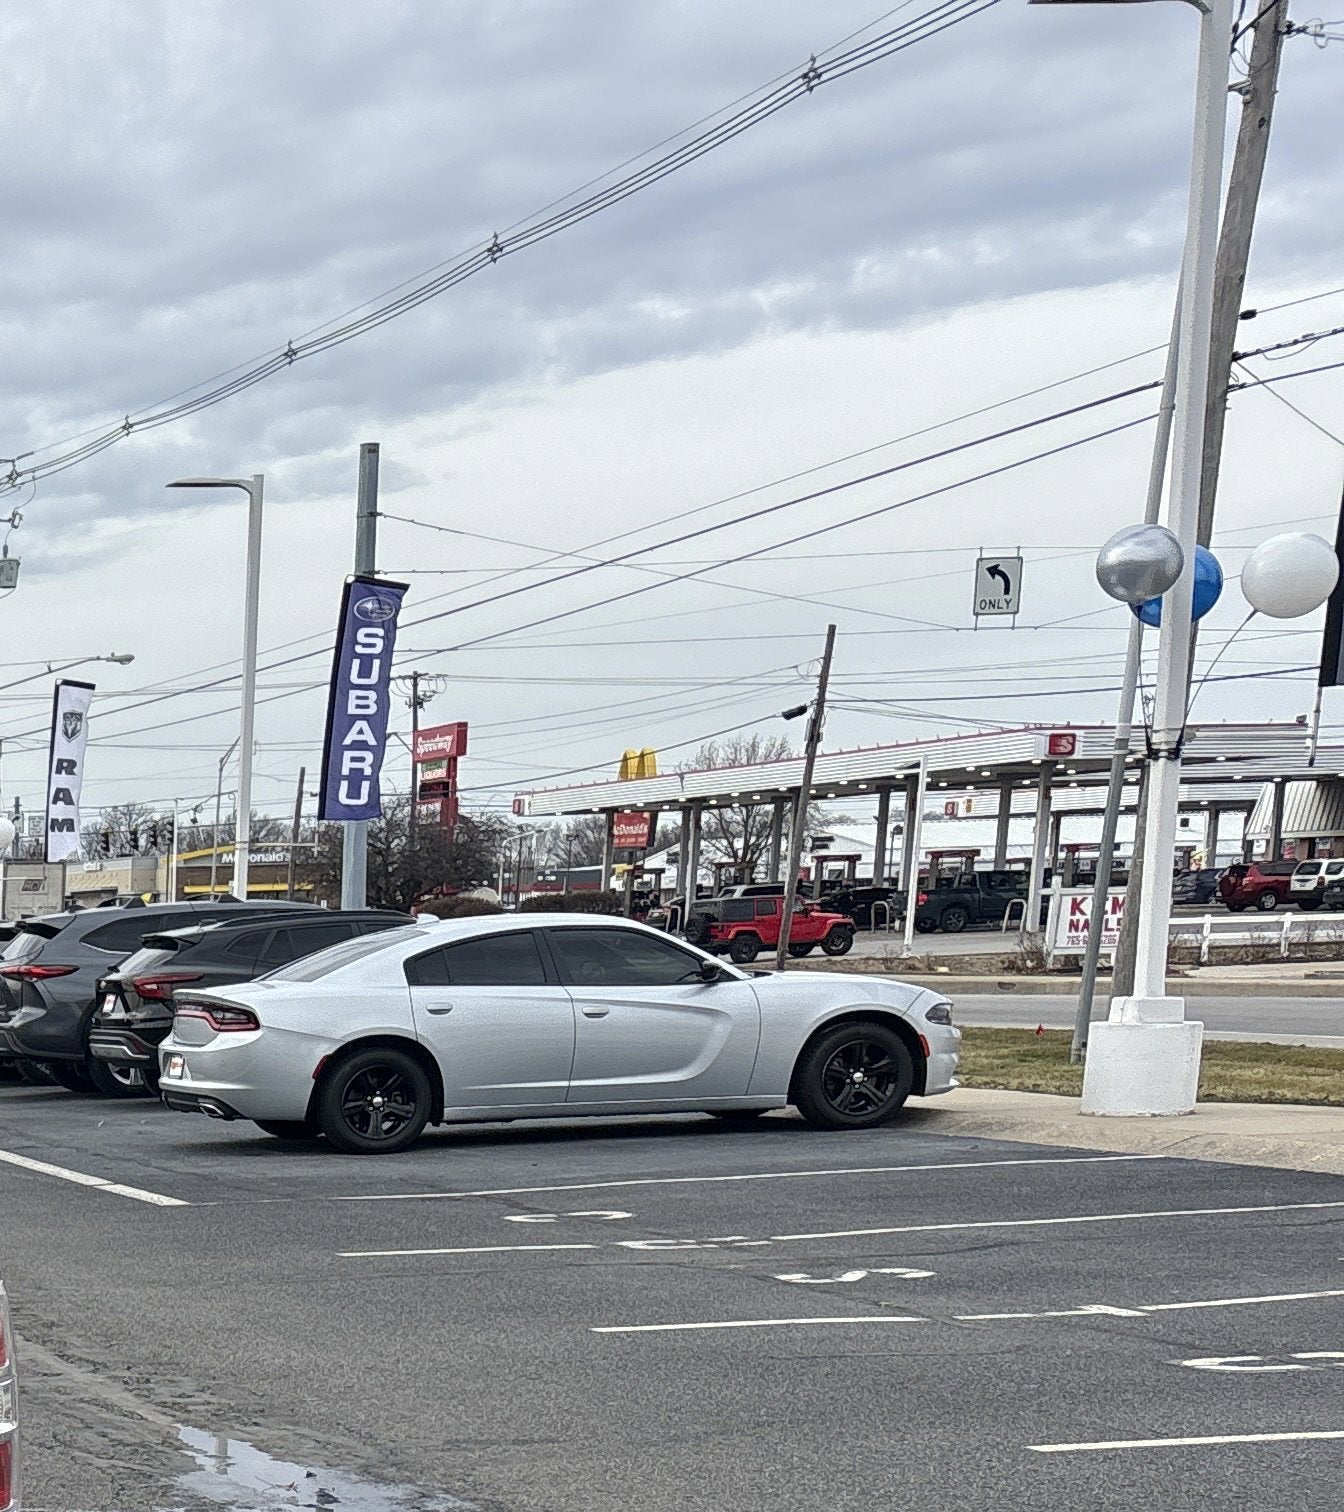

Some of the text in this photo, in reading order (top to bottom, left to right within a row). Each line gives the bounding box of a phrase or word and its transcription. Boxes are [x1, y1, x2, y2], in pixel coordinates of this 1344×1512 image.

[979, 598, 1013, 610] ONLY
[338, 627, 385, 806] SUBARU
[50, 758, 78, 832] RAM
[1069, 896, 1126, 916] KM
[1068, 917, 1123, 933] NAL
